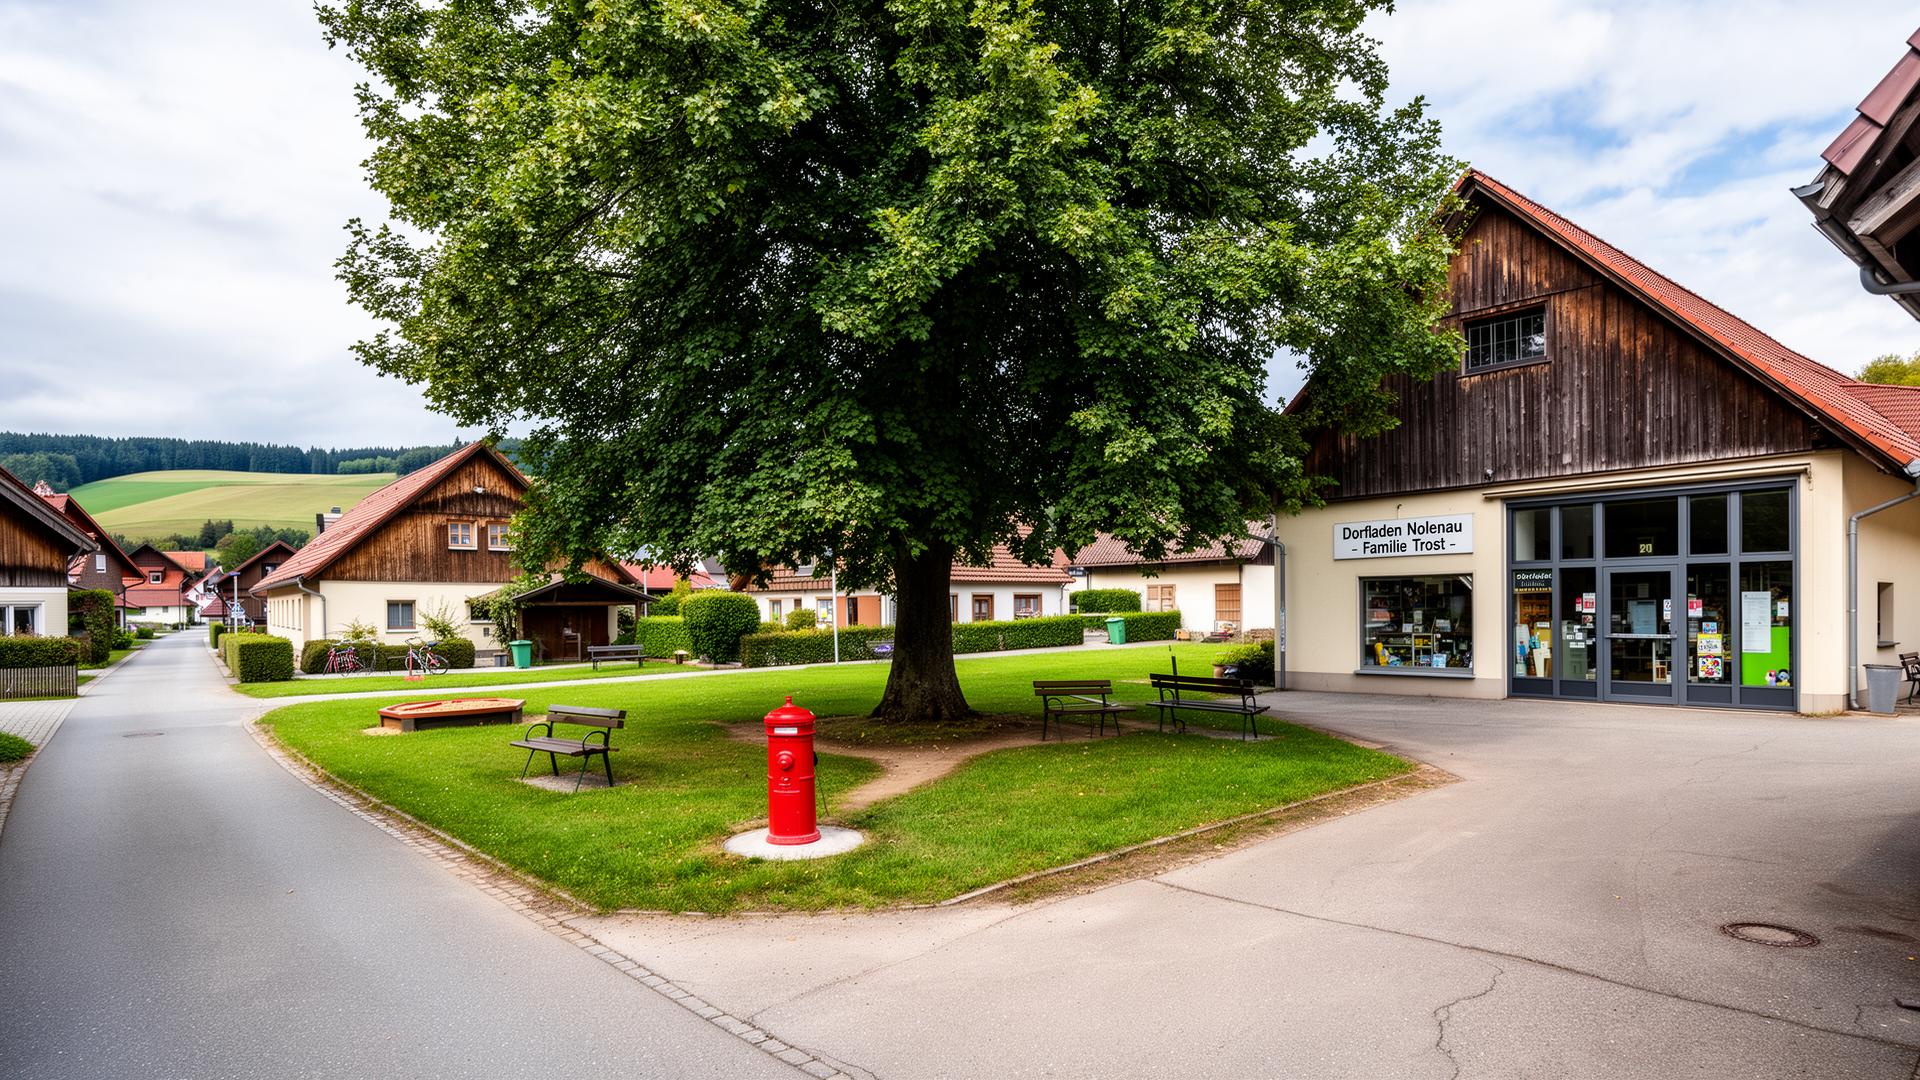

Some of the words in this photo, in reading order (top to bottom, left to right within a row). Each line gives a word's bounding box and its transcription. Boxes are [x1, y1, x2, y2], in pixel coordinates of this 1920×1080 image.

[1342, 524, 1402, 540] Dorfladen
[1407, 521, 1462, 536] Nolenau
[1363, 540, 1407, 554] Familie
[1412, 538, 1446, 552] Trost
[1639, 543, 1653, 554] 20
